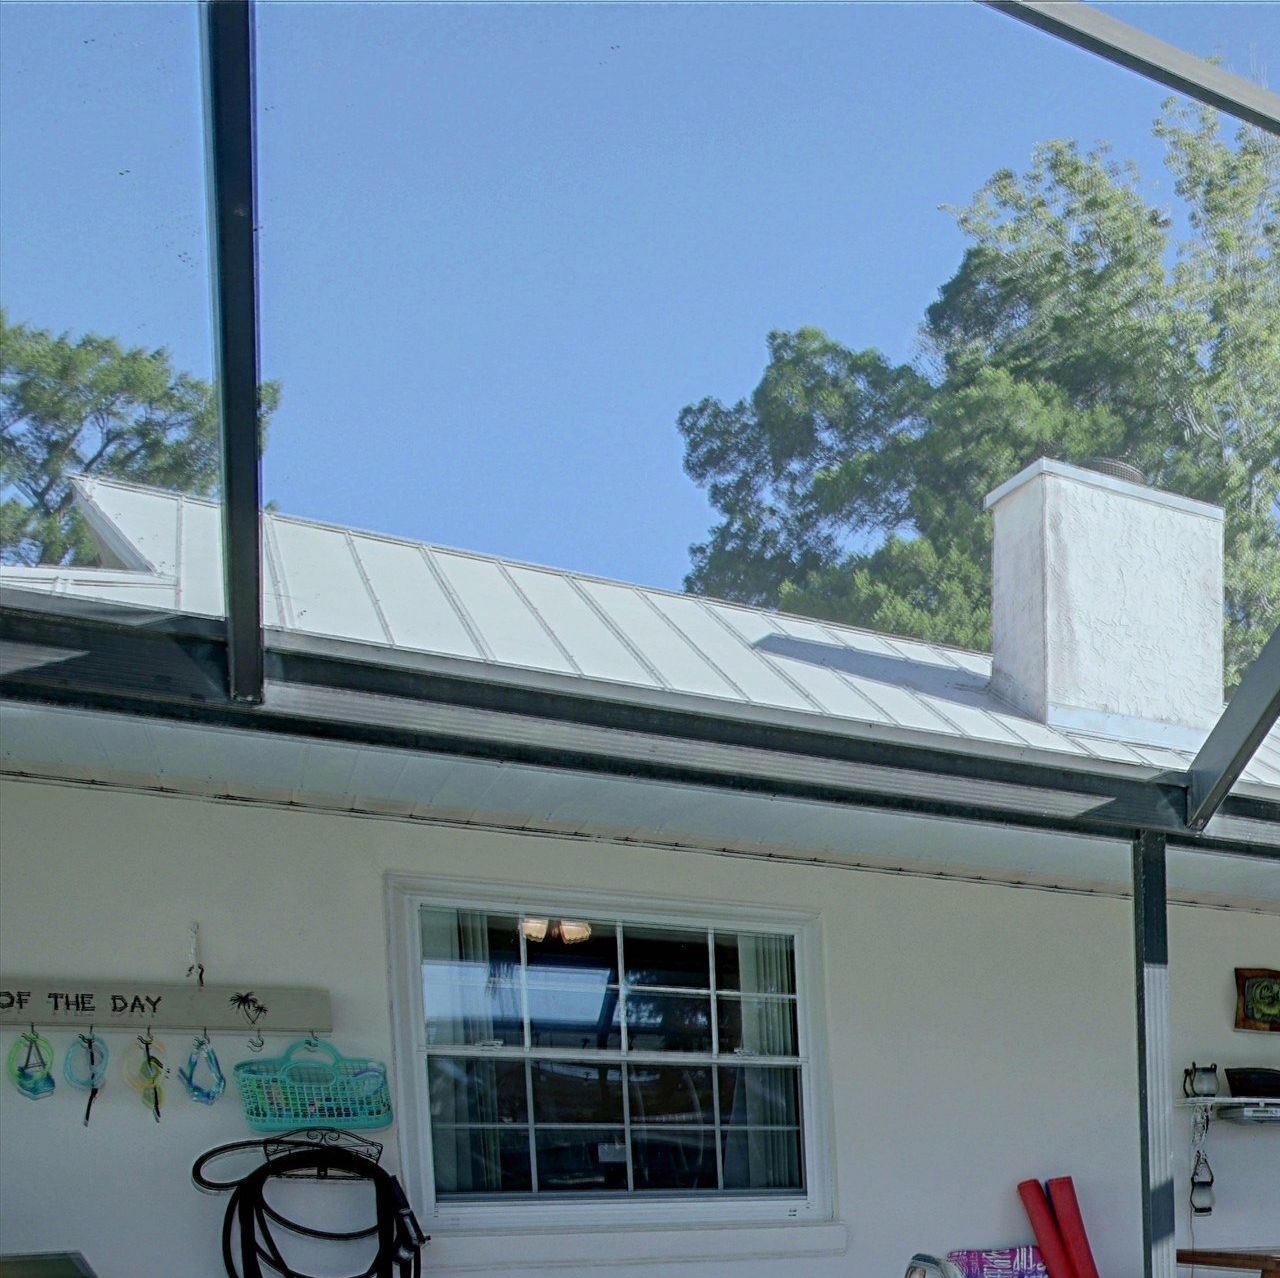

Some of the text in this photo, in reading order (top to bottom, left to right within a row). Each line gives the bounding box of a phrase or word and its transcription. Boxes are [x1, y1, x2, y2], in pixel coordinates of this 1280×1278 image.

[0, 991, 162, 1013] OF THE DAY
